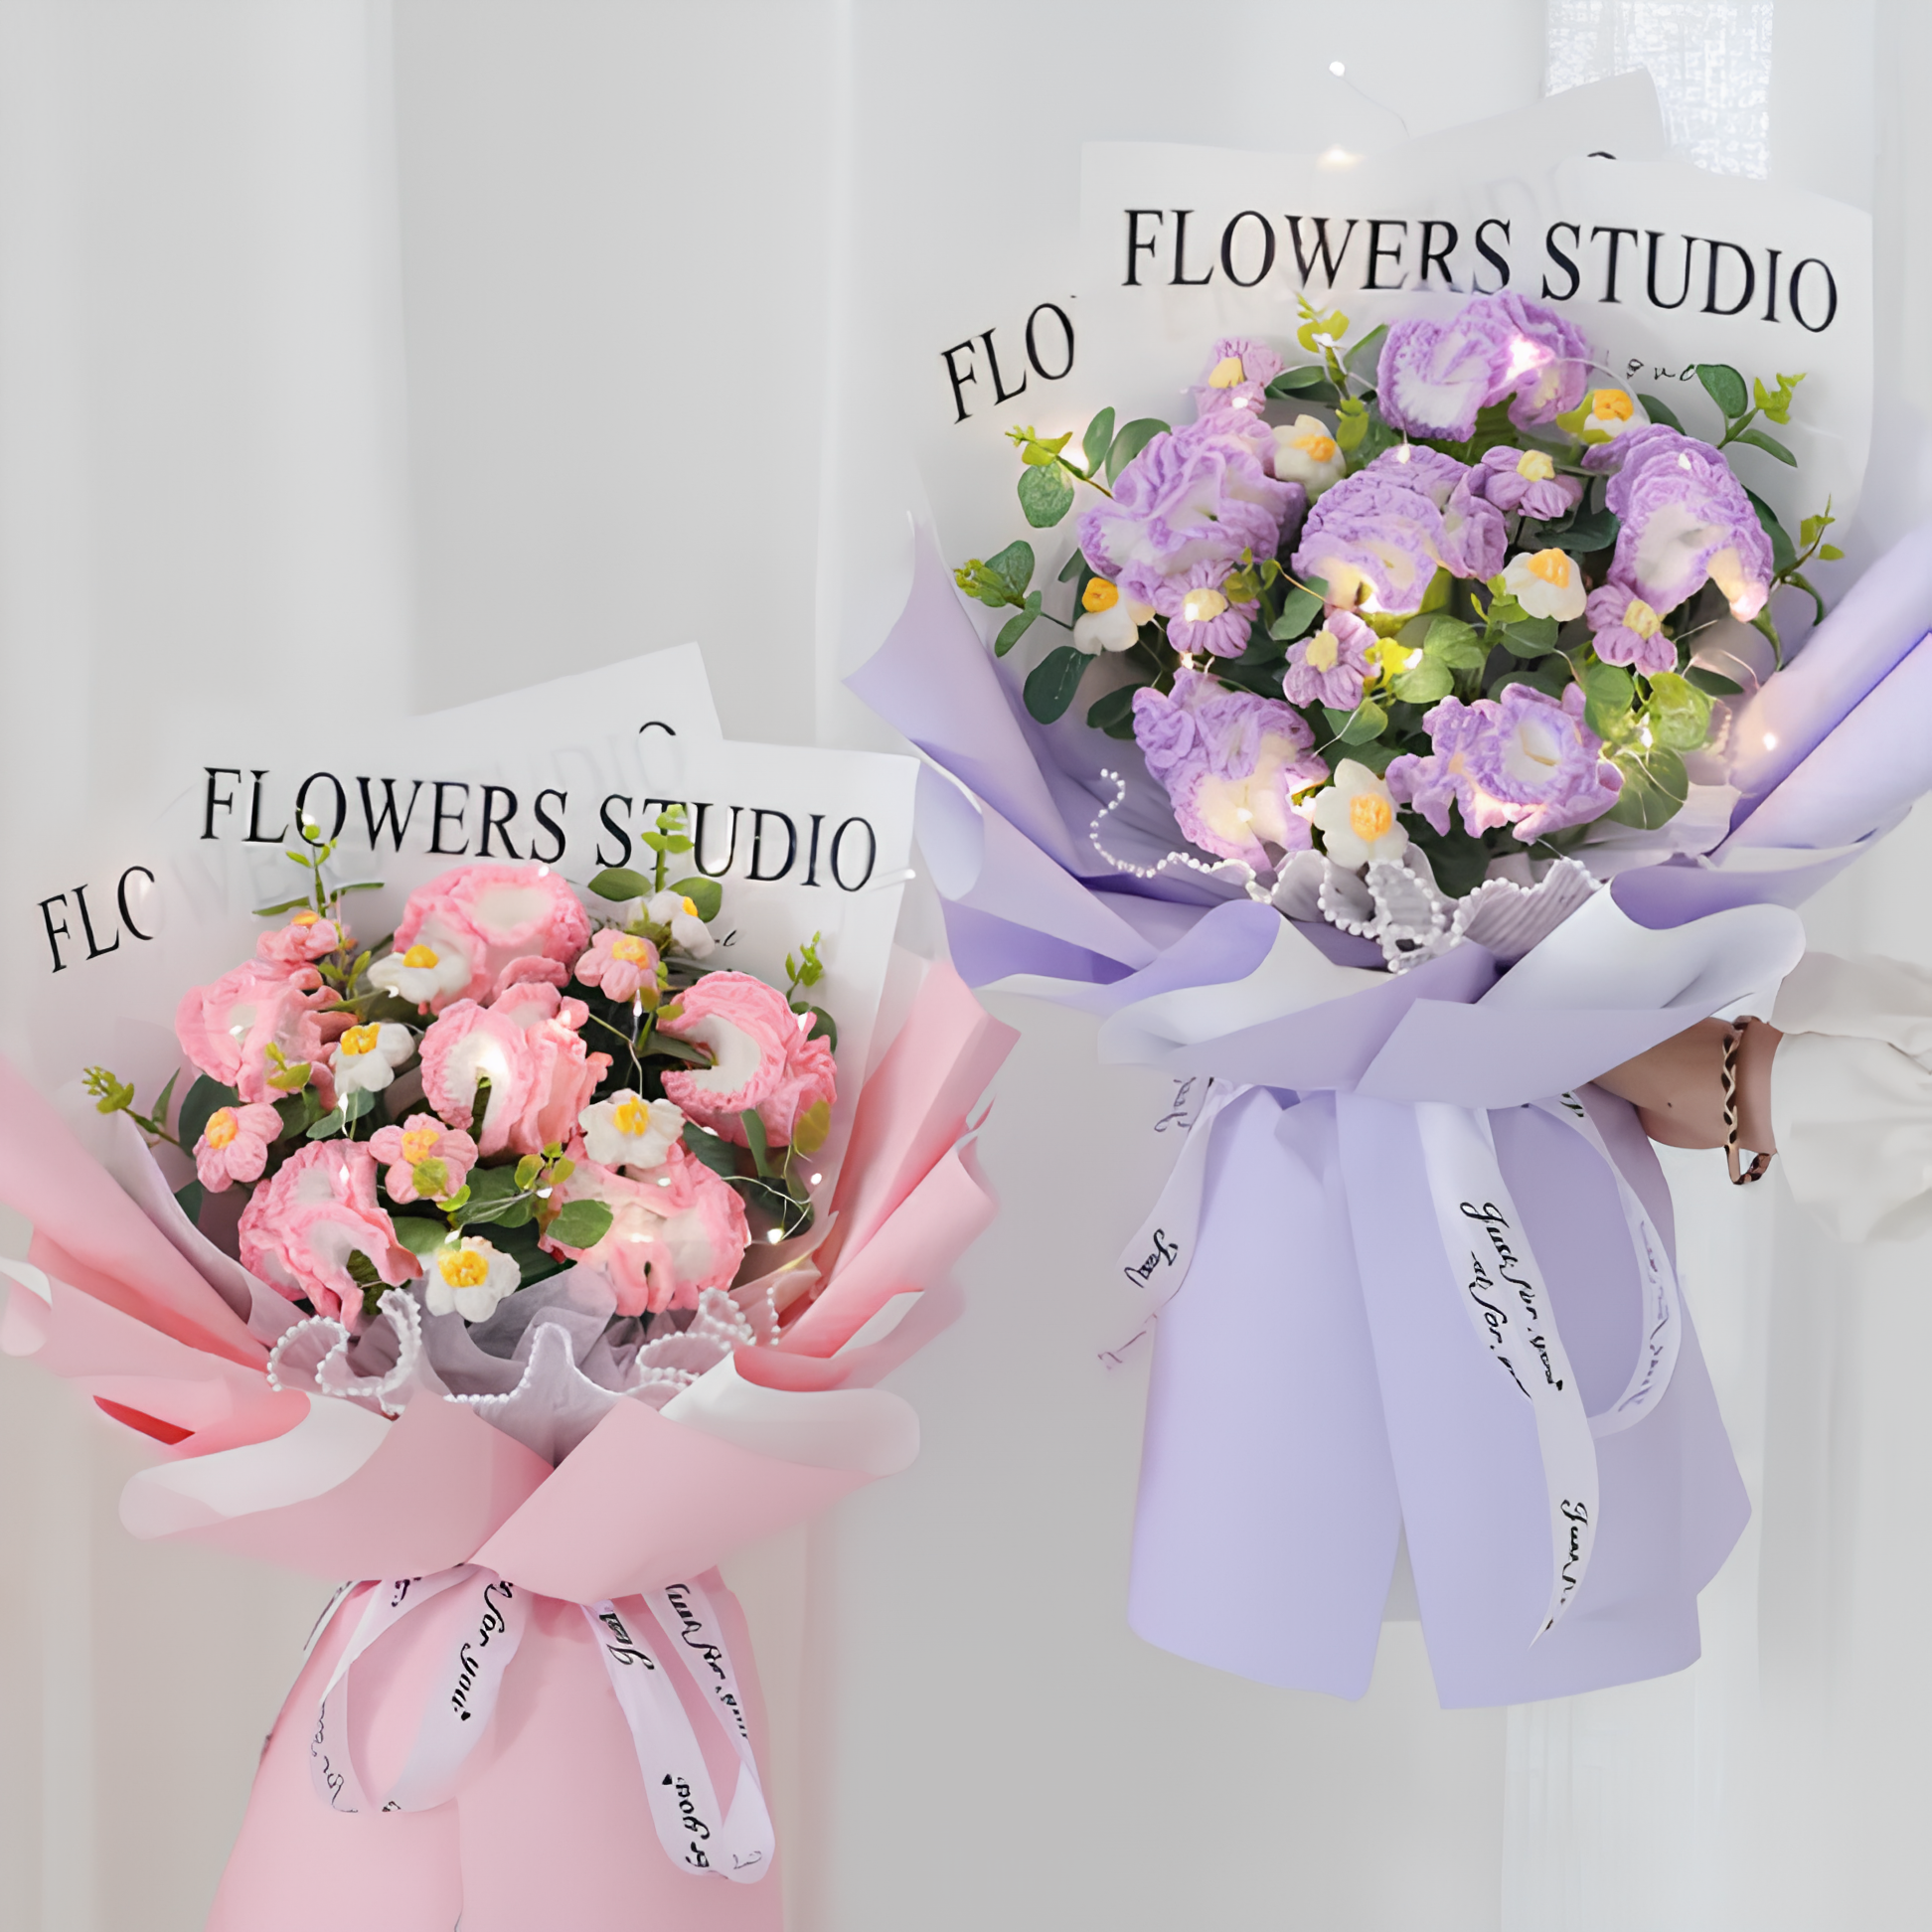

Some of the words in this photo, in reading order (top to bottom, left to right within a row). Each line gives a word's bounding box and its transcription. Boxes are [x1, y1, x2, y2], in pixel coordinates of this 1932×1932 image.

[1122, 209, 1512, 296] FLOWERS
[1539, 221, 1839, 333] STUDIO
[200, 766, 568, 864] FLOWERS
[595, 793, 877, 892] STUDIO
